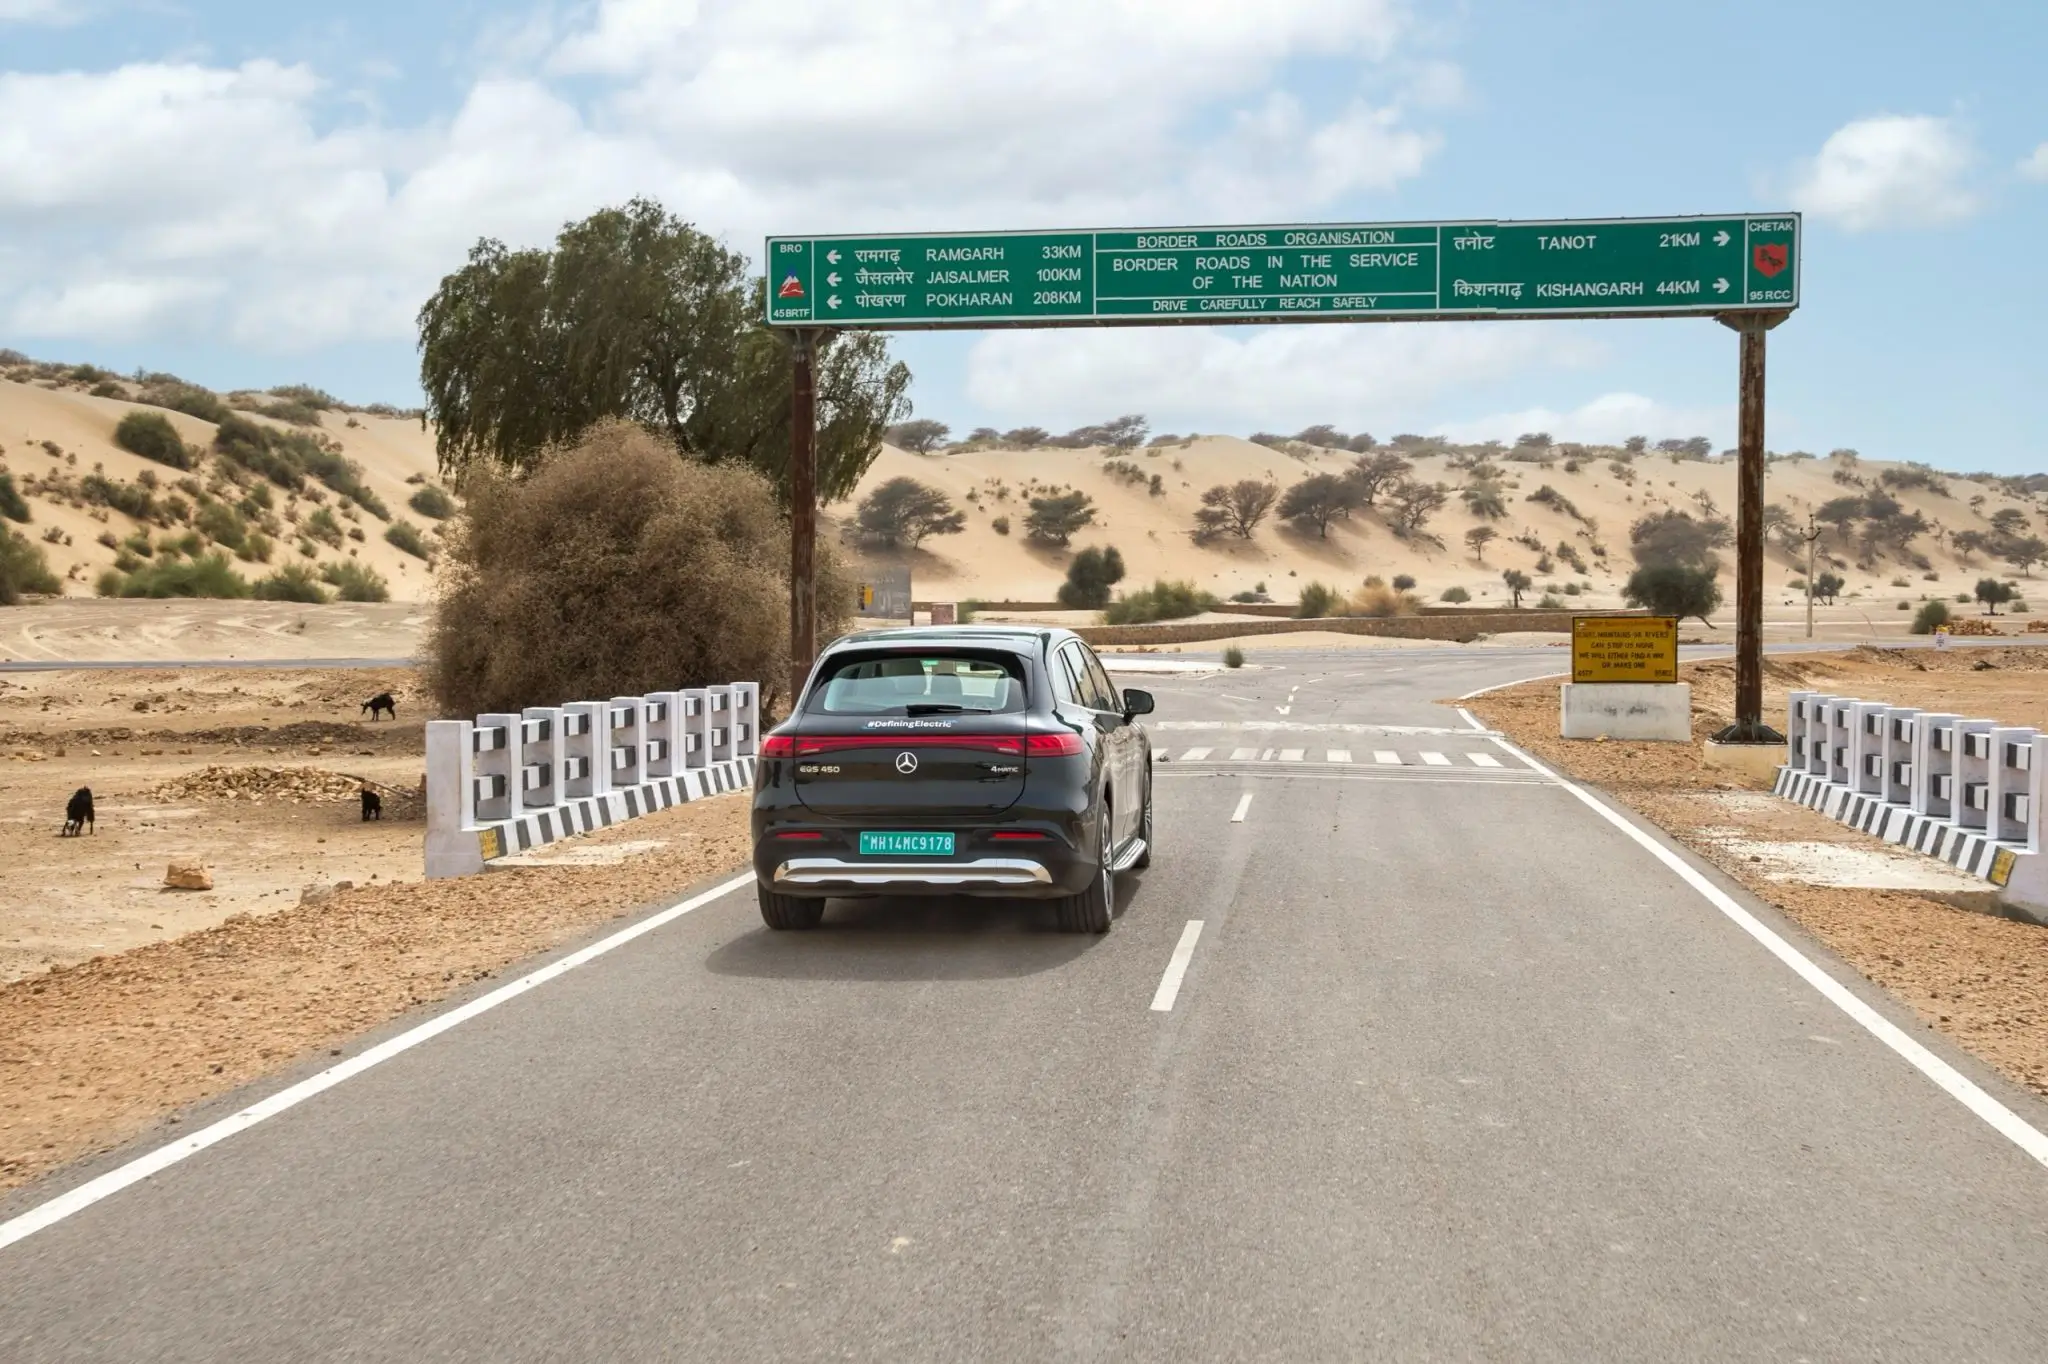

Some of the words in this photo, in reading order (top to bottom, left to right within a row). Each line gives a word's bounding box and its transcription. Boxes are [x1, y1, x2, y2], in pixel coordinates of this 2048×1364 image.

[1749, 221, 1793, 232] CHETAK
[1137, 235, 1197, 248] BORDER
[1216, 234, 1267, 246] ROADS
[1285, 231, 1395, 244] ORGANISATION
[1454, 232, 1495, 250] तनोट
[1538, 236, 1596, 249] TANOT
[1660, 233, 1699, 247] 21KM
[780, 244, 803, 253] BRO
[927, 248, 1003, 261] RAMGARH
[1043, 245, 1081, 258] 33KM
[855, 250, 901, 264] रामगढ़
[1114, 258, 1177, 271] BORDER
[1196, 256, 1250, 269] ROADS
[1268, 256, 1282, 268] IN
[1301, 255, 1331, 267] THE
[1350, 253, 1417, 267] SERVICE
[855, 267, 914, 284] जैसलमेर
[927, 270, 1009, 283] JAISALMER
[1037, 268, 1080, 281] 100KM
[1193, 276, 1213, 289] OF
[1232, 276, 1262, 288] THE
[1280, 274, 1337, 287] NATION
[1453, 279, 1524, 299] किशनगढ़
[1537, 282, 1643, 296] KISHANGARH
[1656, 280, 1699, 294] 44KM
[855, 290, 906, 307] पोखरण
[927, 293, 1012, 306] POKHARAN
[1034, 291, 1081, 304] 208KM
[1153, 301, 1188, 312] DRIVE
[1200, 299, 1267, 311] CAREFULLY
[1280, 298, 1320, 308] REACH
[1333, 298, 1377, 308] SAFELY
[867, 720, 953, 729] #DefiningElectric
[820, 765, 840, 773] 450
